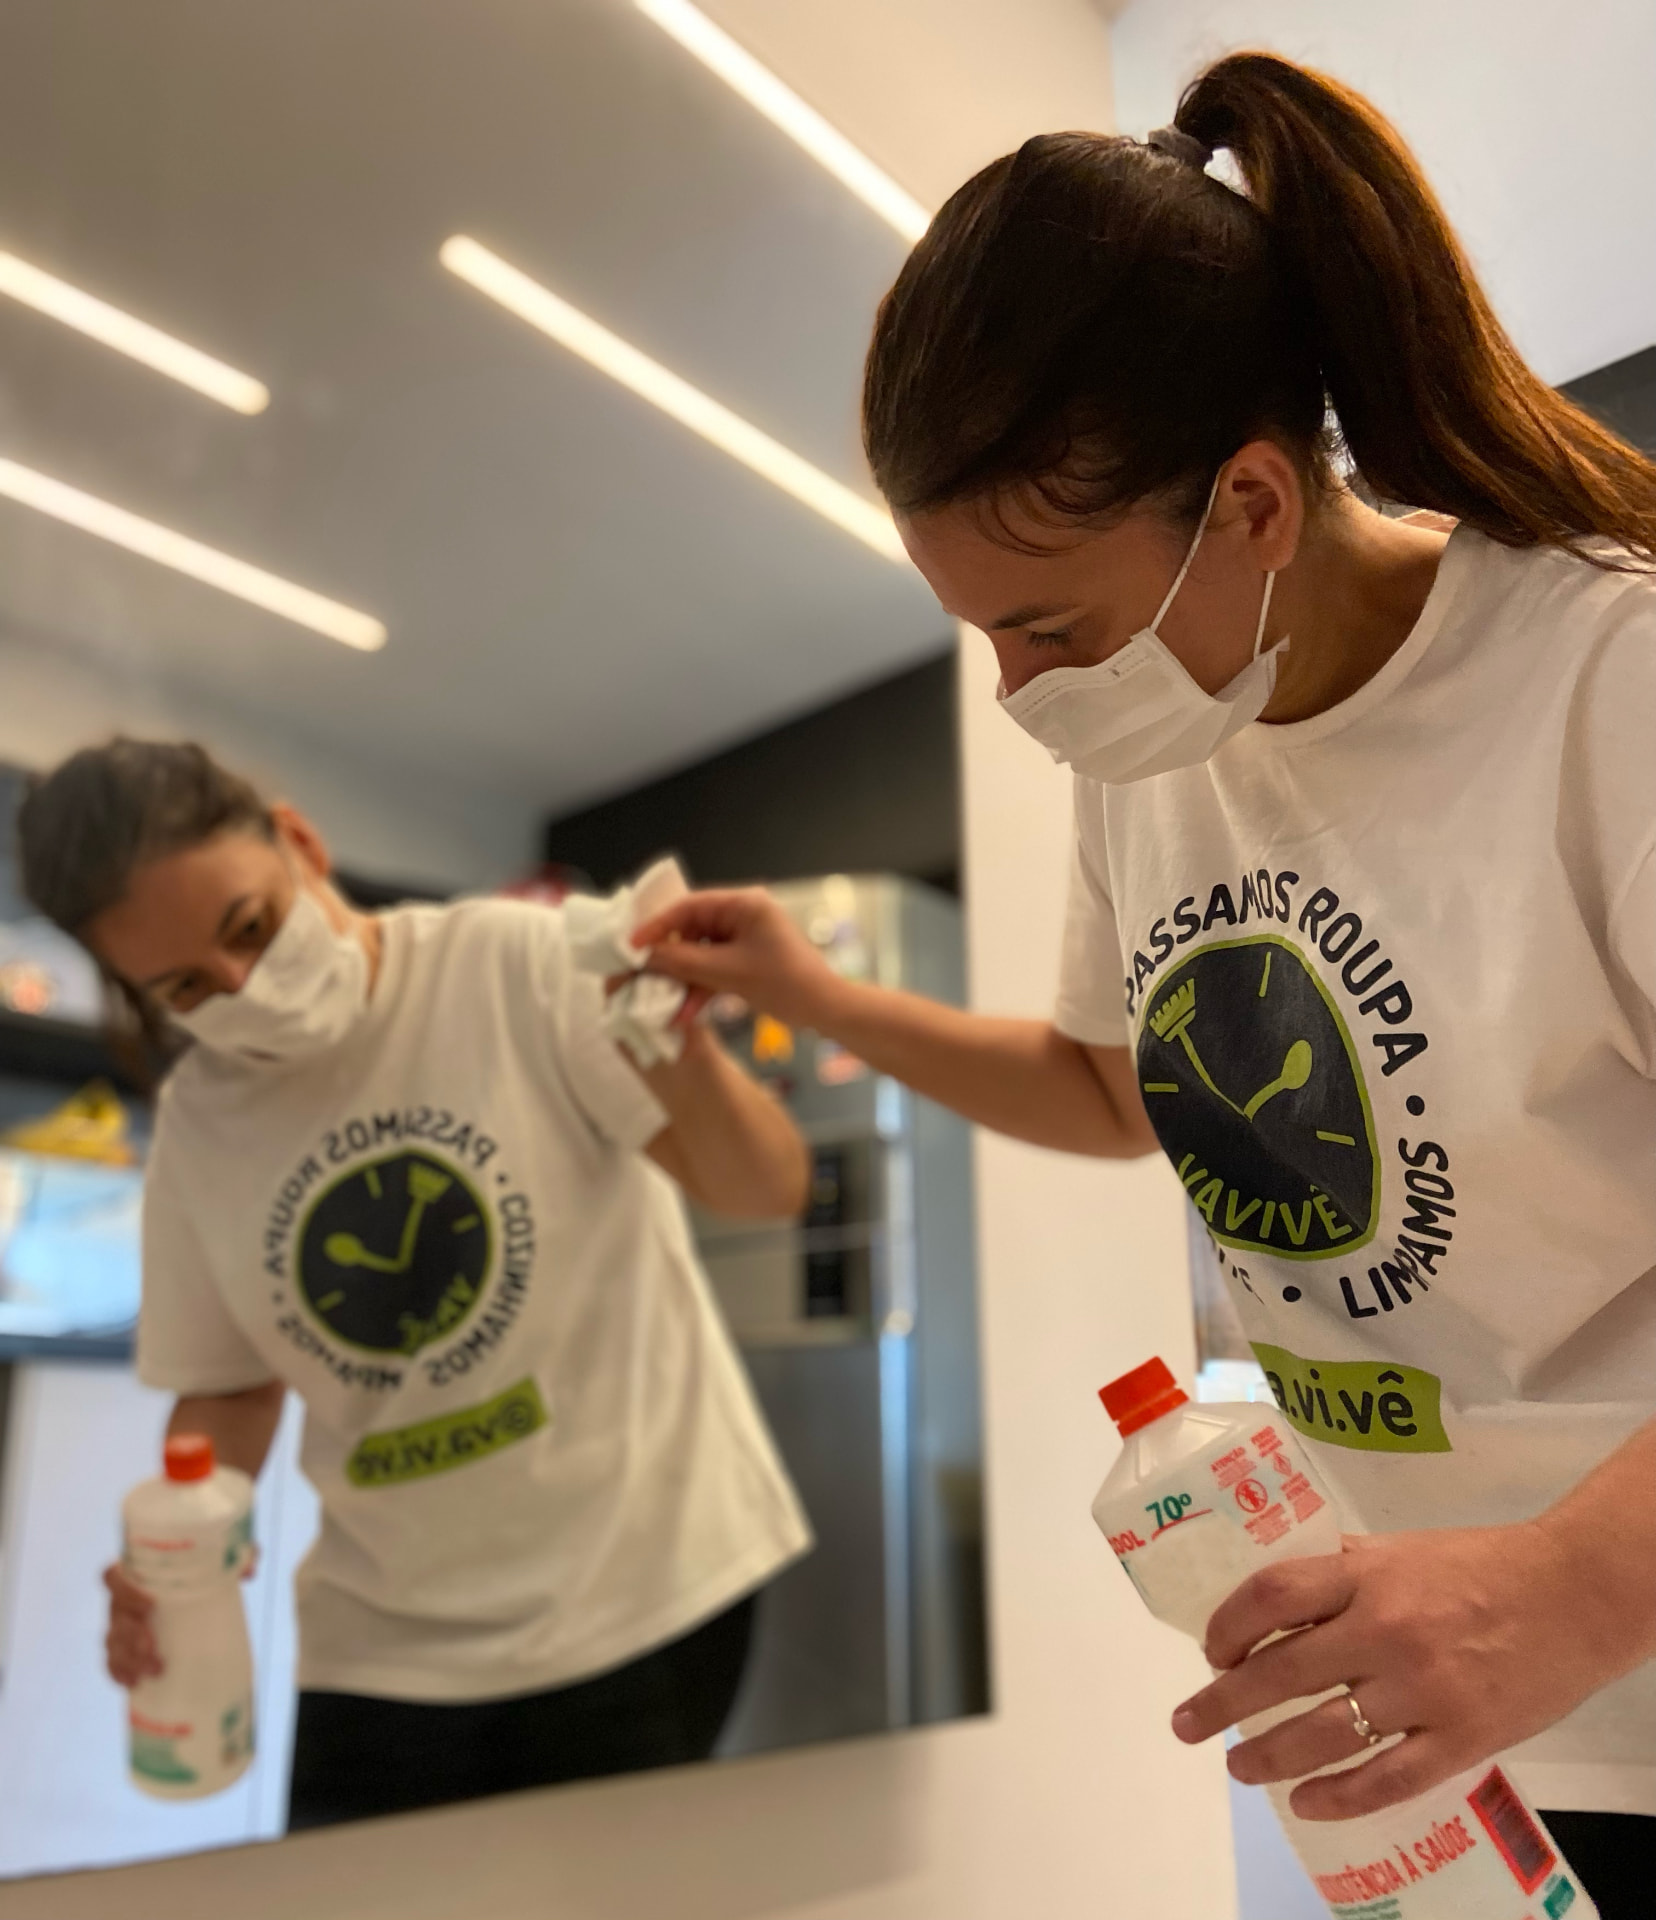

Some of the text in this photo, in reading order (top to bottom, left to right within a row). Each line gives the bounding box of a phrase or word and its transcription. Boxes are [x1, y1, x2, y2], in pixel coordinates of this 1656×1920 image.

[1298, 886, 1428, 1077] ROUPA
[1177, 1152, 1352, 1245] VAVIVÊ
[1340, 1137, 1456, 1318] LIMPAMOS
[1107, 1529, 1146, 1557] OOL
[1414, 1815, 1477, 1873] SAÚDE
